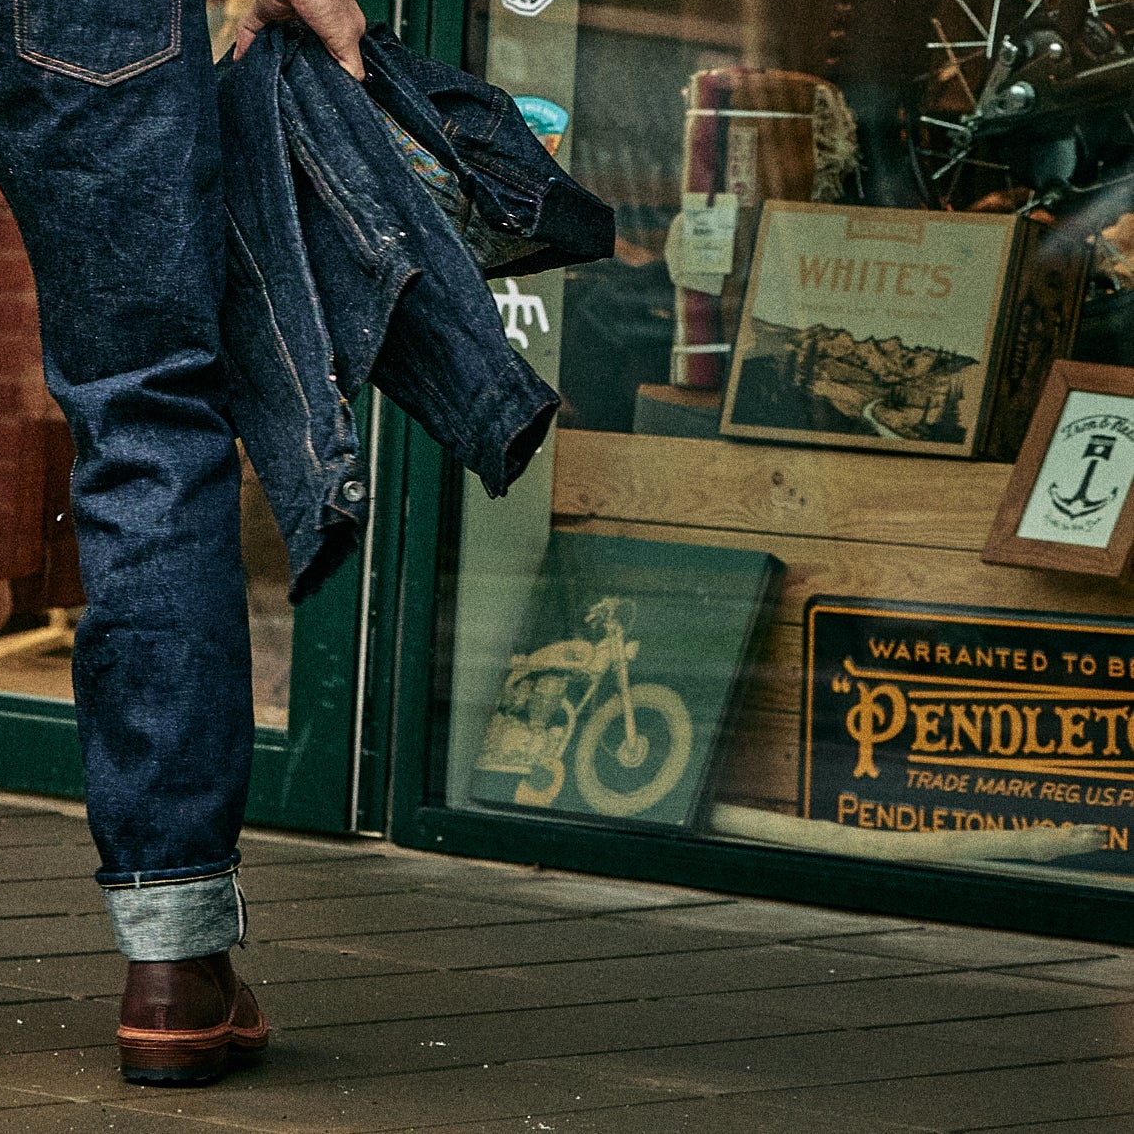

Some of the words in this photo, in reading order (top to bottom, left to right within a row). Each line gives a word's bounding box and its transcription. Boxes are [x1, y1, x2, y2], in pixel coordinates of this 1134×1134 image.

[798, 254, 953, 299] WHITE'S
[869, 638, 1049, 673] WARRANTED
[1061, 652, 1097, 676] TO
[906, 769, 970, 794] TRADE
[974, 774, 1036, 800] MARK
